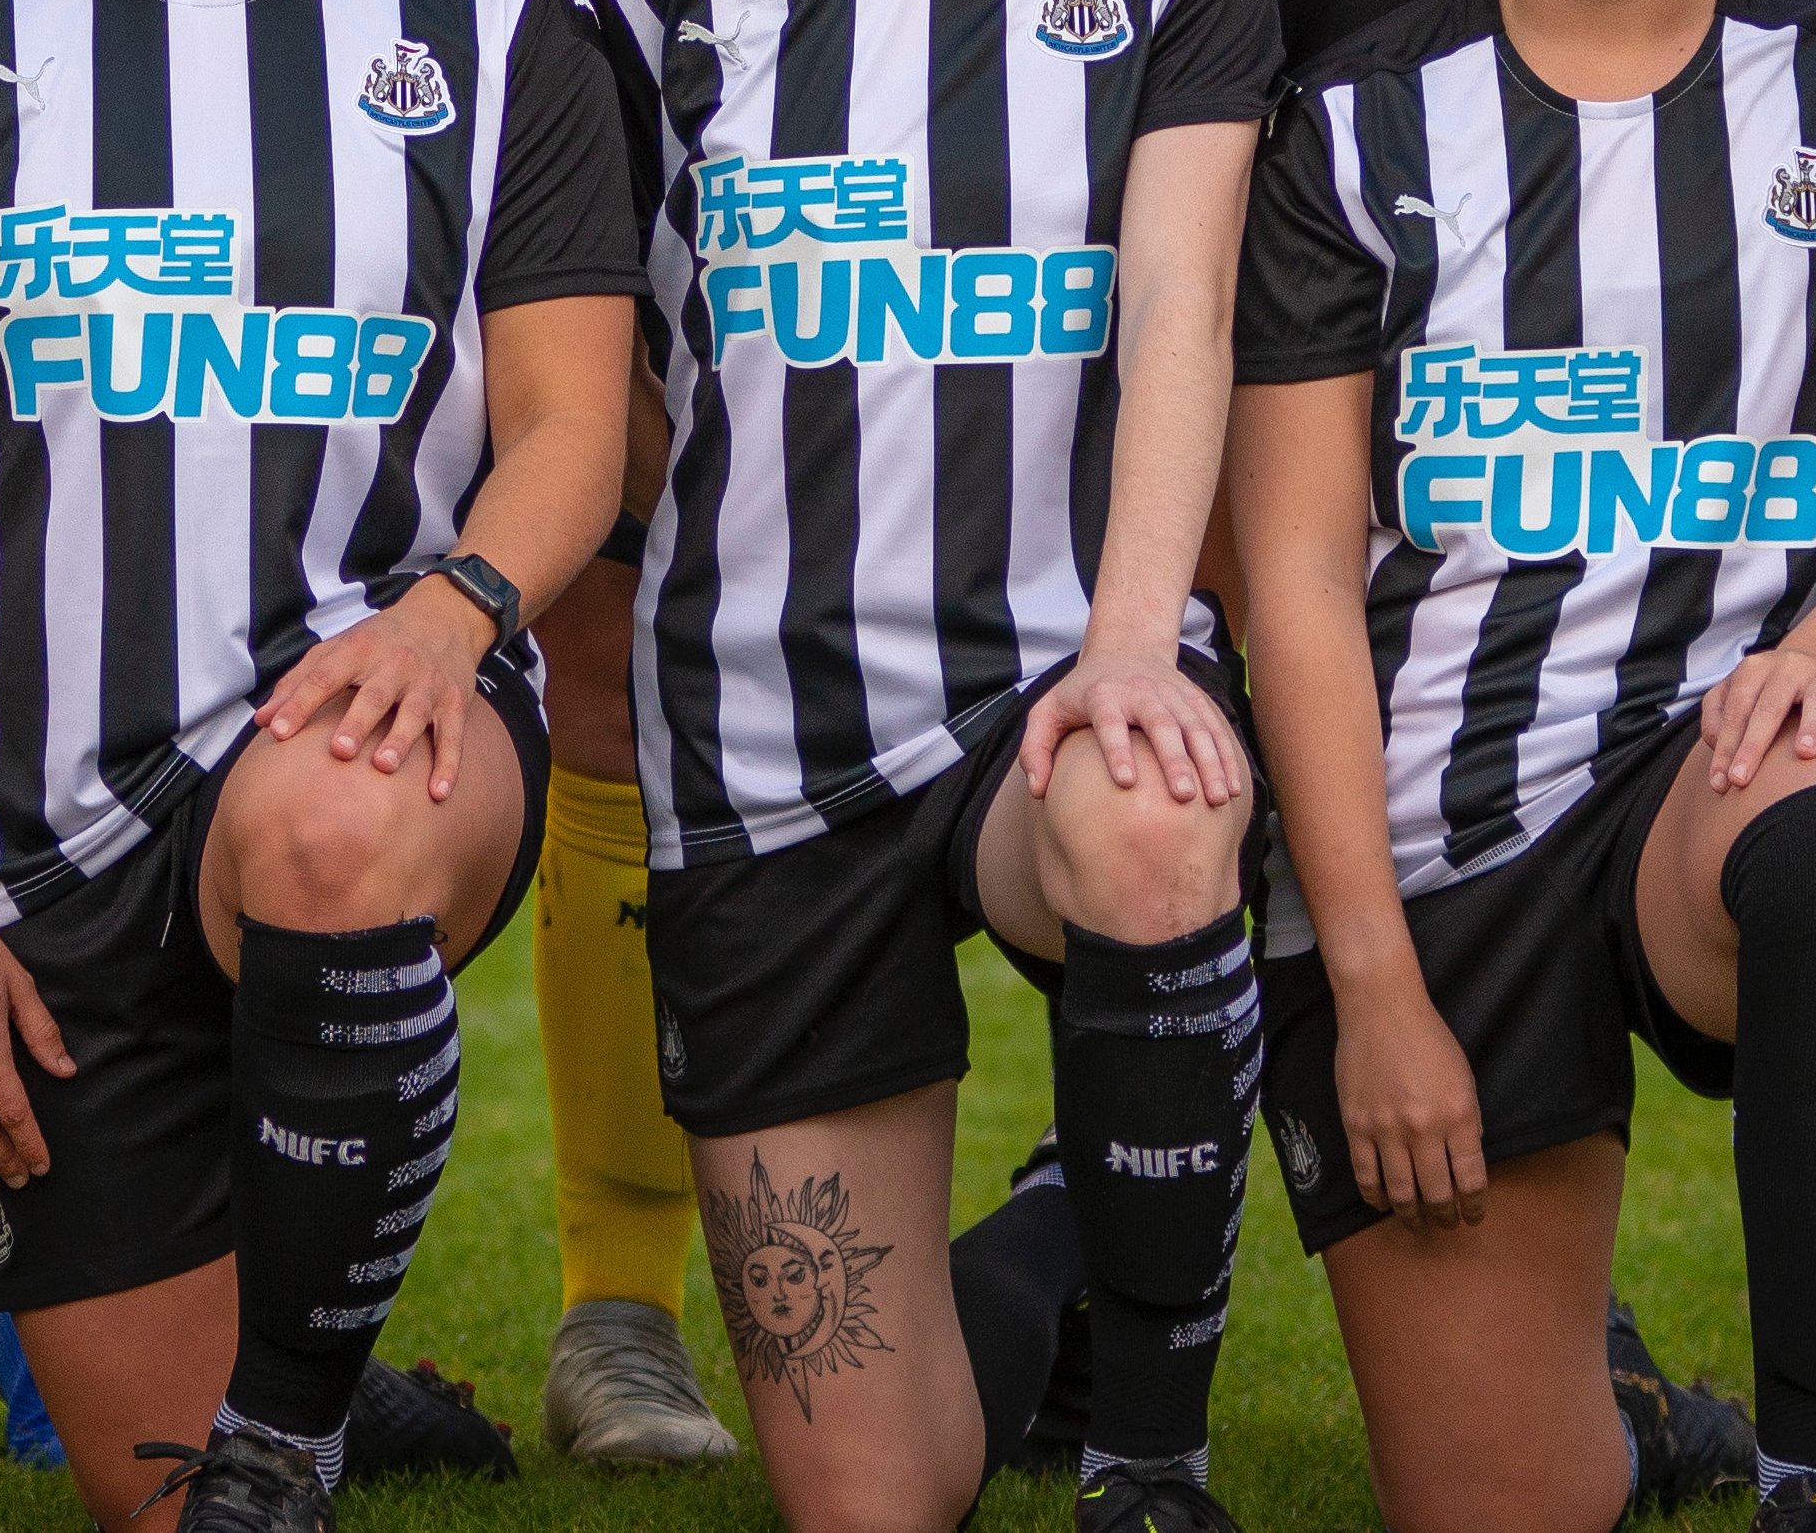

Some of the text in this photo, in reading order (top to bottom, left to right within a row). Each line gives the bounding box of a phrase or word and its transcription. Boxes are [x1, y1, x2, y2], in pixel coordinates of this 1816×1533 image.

[698, 156, 909, 251] 乐天堂
[706, 250, 1117, 367] FUN88
[3, 312, 433, 419] FUN88
[1399, 344, 1642, 439] 乐天堂
[257, 1115, 367, 1167] NUFC
[1104, 1140, 1219, 1179] NUFC
